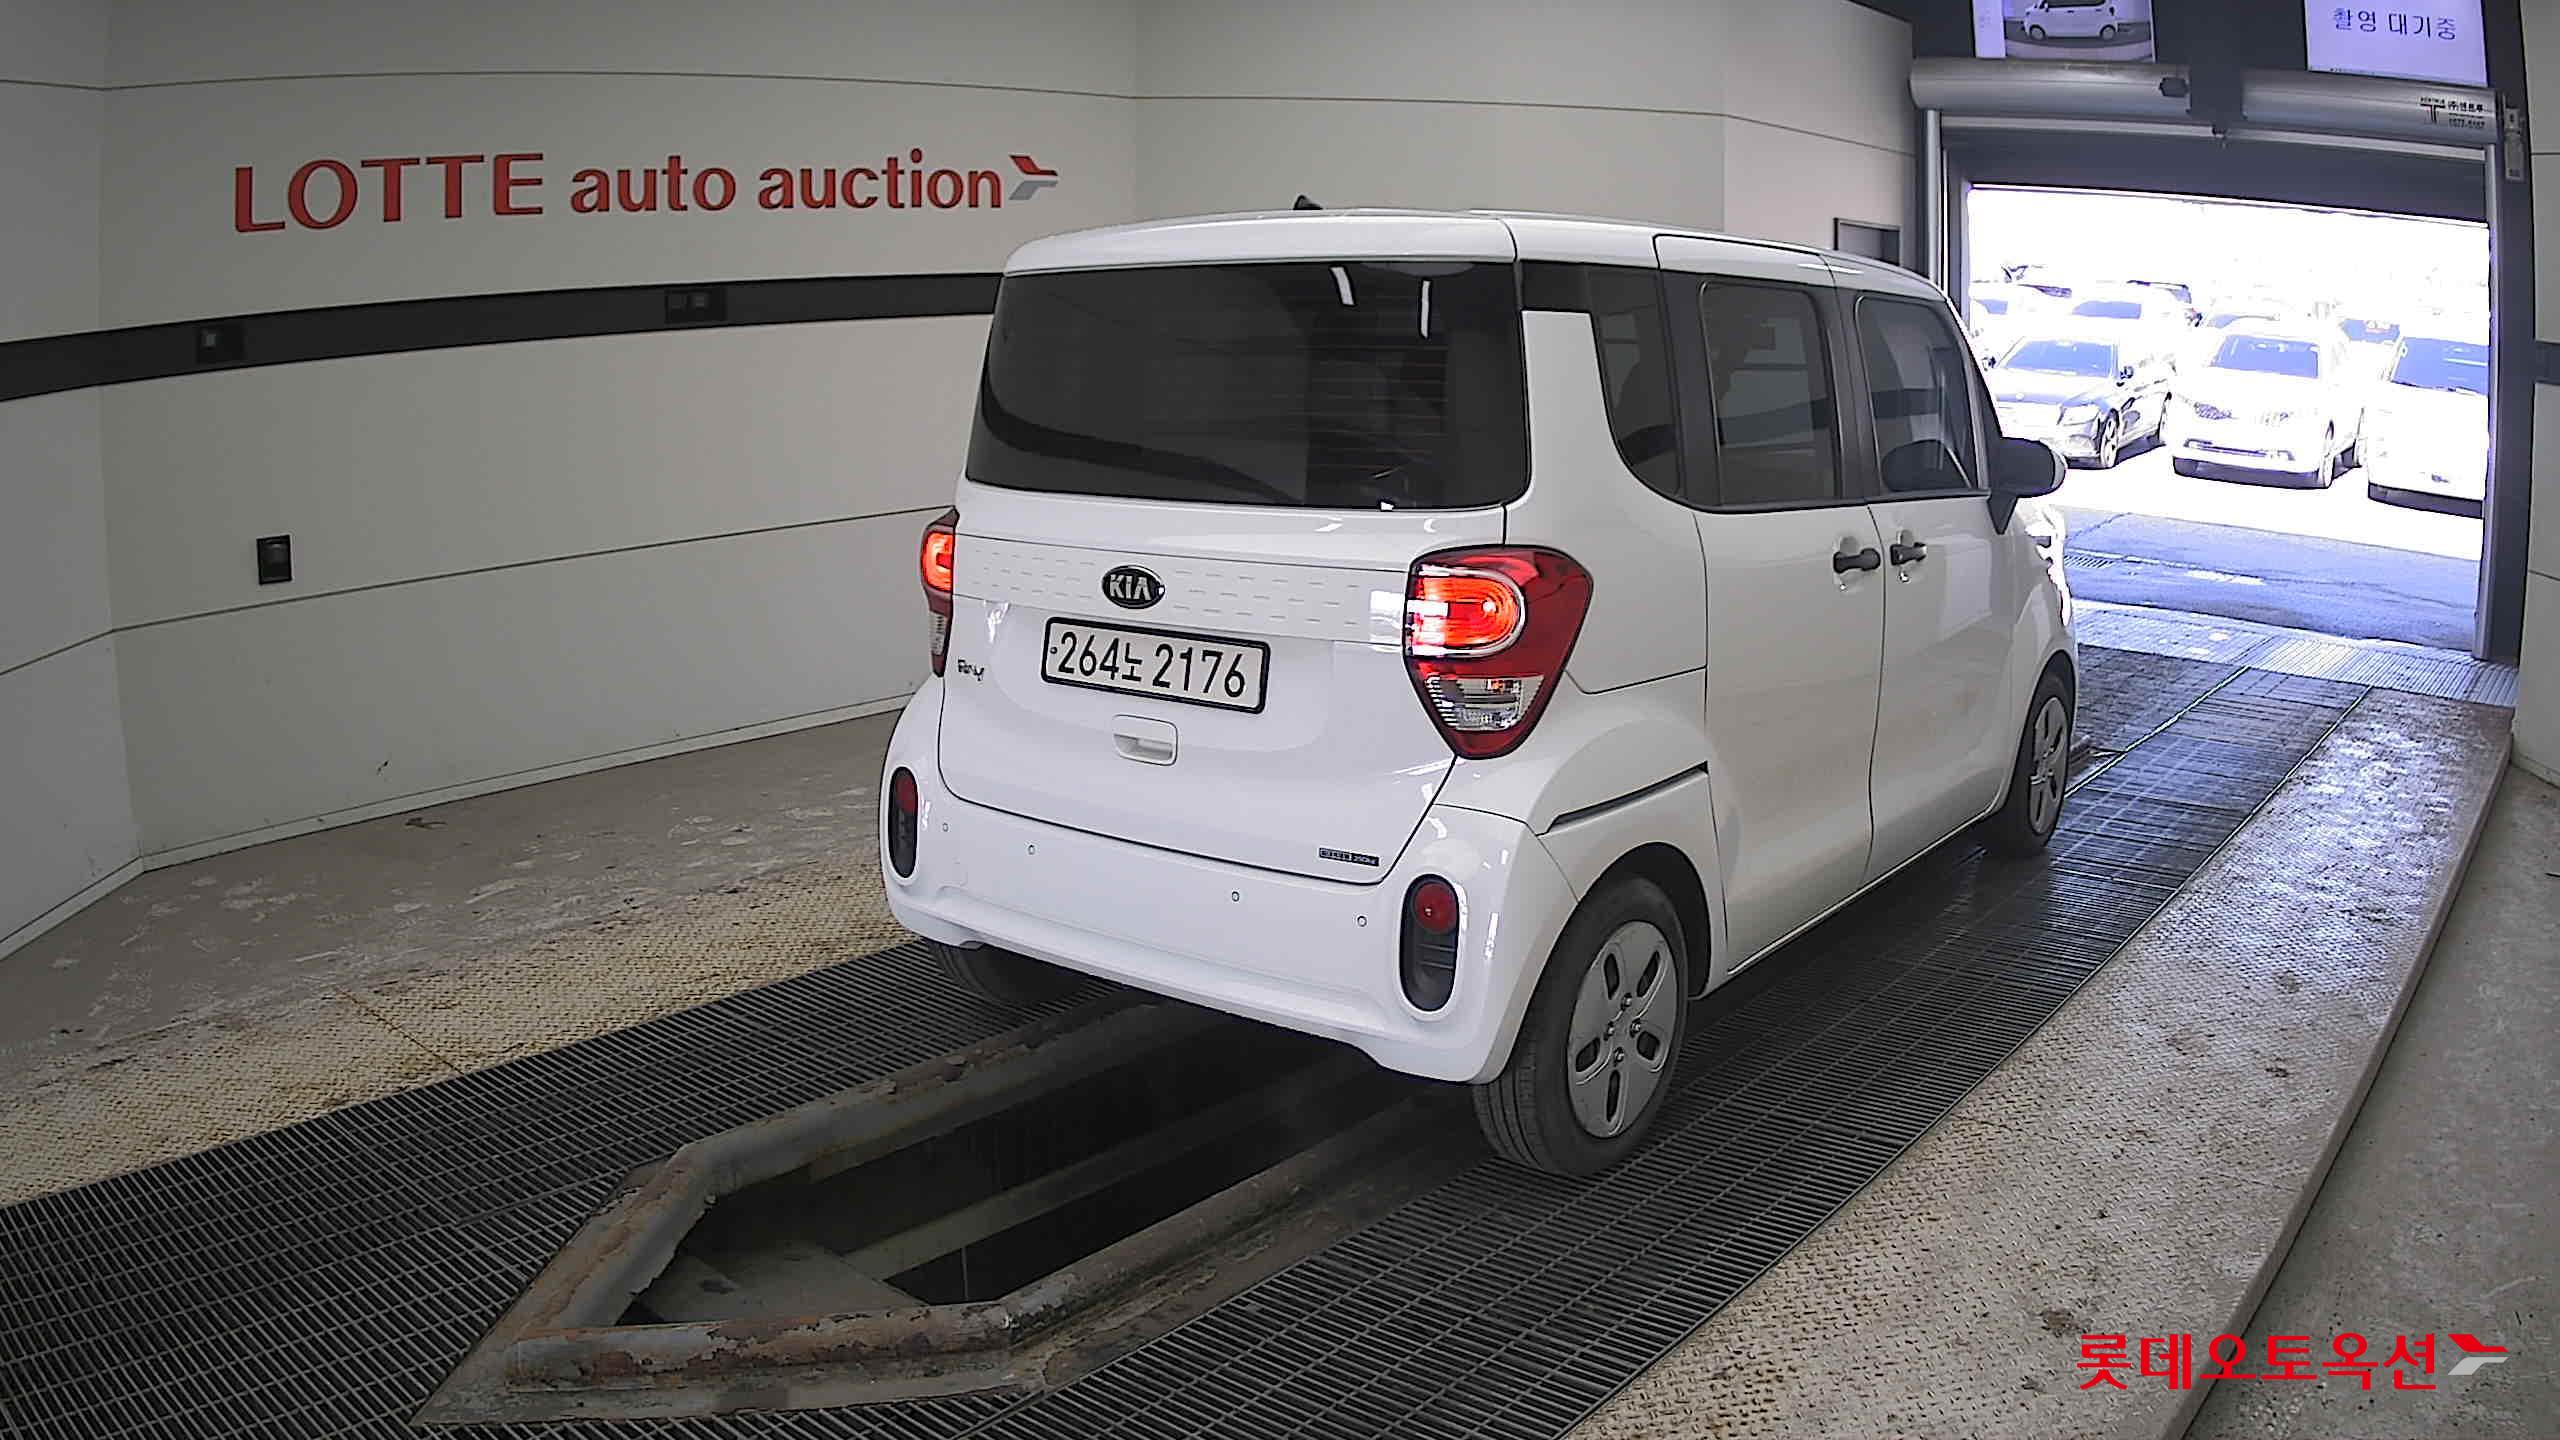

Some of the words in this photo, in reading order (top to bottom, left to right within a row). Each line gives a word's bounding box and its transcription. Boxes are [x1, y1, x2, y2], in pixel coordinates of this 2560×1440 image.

[2388, 12, 2457, 41] 대기중
[234, 152, 544, 233] LOTTE
[569, 154, 737, 213] auto
[758, 147, 1002, 210] auction
[1108, 573, 1151, 601] KIA
[1057, 631, 1143, 682] 264노
[1151, 643, 1246, 698] 2176
